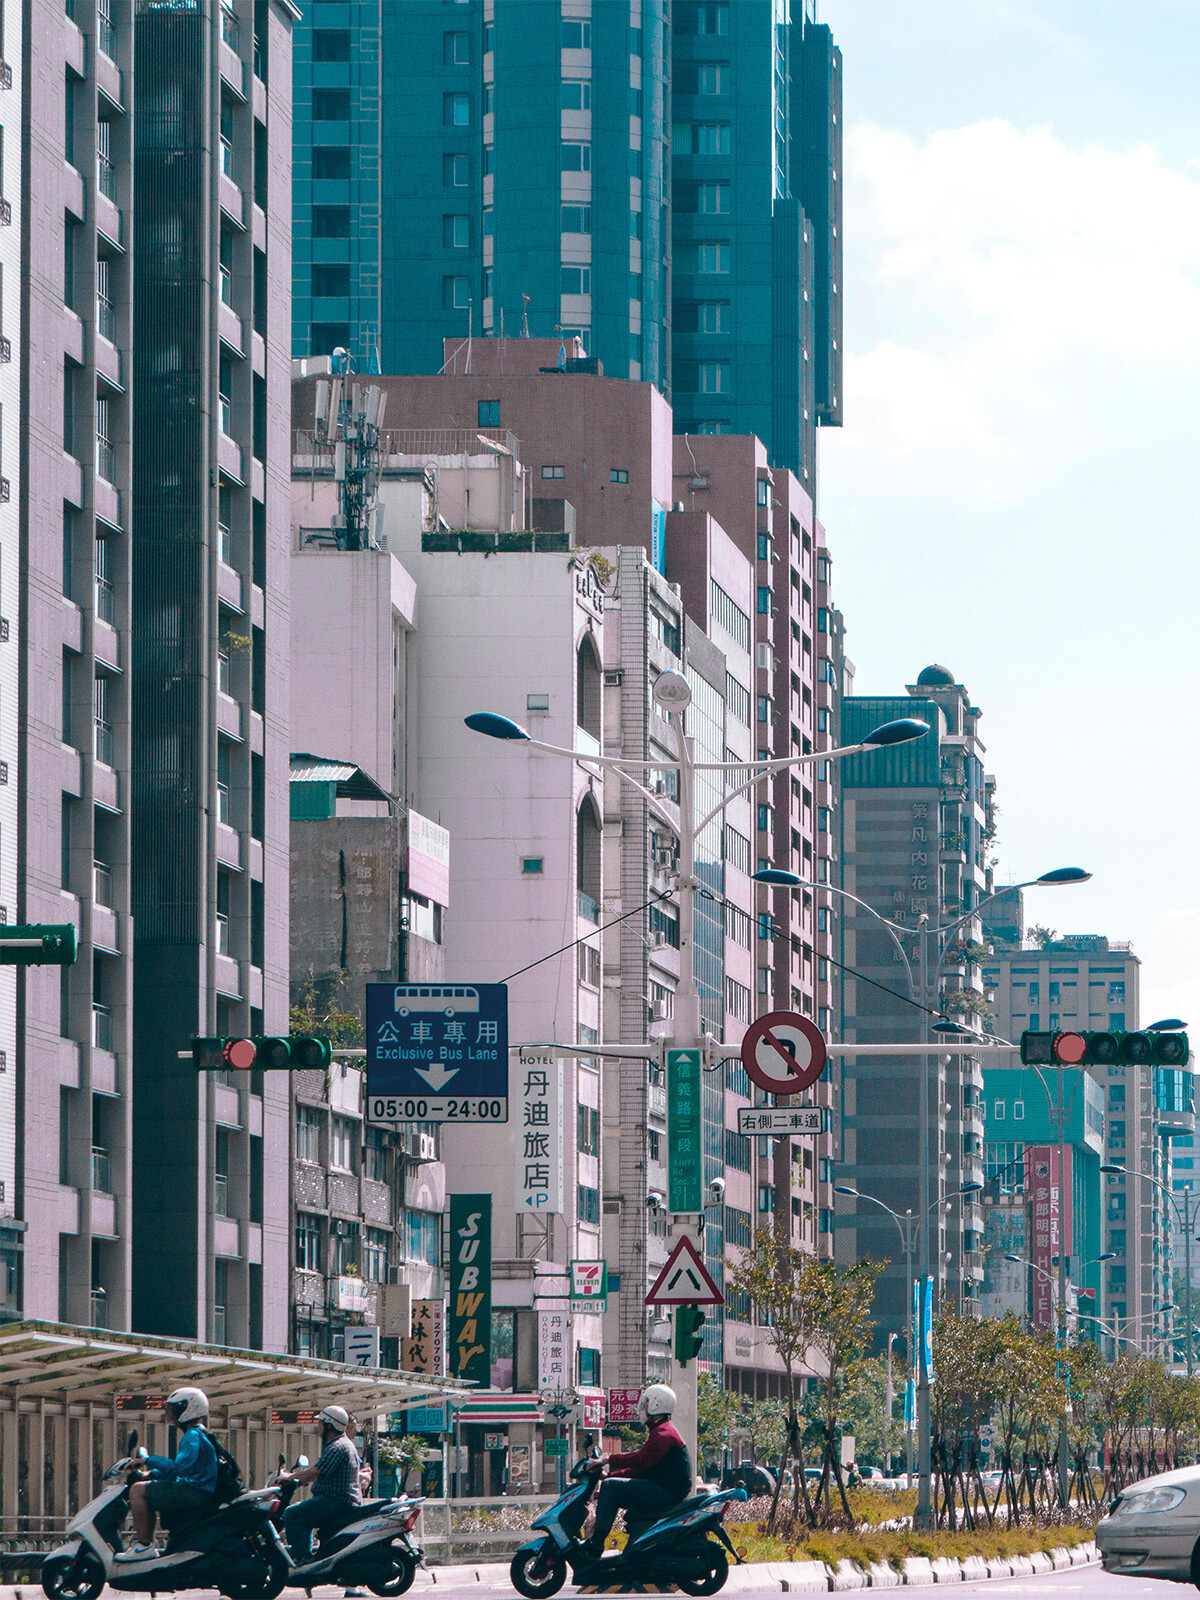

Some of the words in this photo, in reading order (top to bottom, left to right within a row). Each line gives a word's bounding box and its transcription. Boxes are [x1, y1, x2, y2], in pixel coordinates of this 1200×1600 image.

[376, 1046, 434, 1060] Exclusive
[440, 1046, 463, 1060] Bus
[468, 1047, 498, 1060] Lane
[377, 1020, 498, 1044] 公車專用
[520, 1057, 553, 1065] HOTEL
[523, 1070, 550, 1189] 丹迪旅店
[676, 1063, 692, 1152] 信義路三段
[742, 1114, 819, 1129] 右側二車道
[536, 1193, 549, 1208] P
[1036, 1187, 1049, 1248] 多郎明哥
[456, 1212, 486, 1371] SUBWAY
[1037, 1256, 1048, 1325] HOTEL
[551, 1316, 562, 1373] 丹迪旅店
